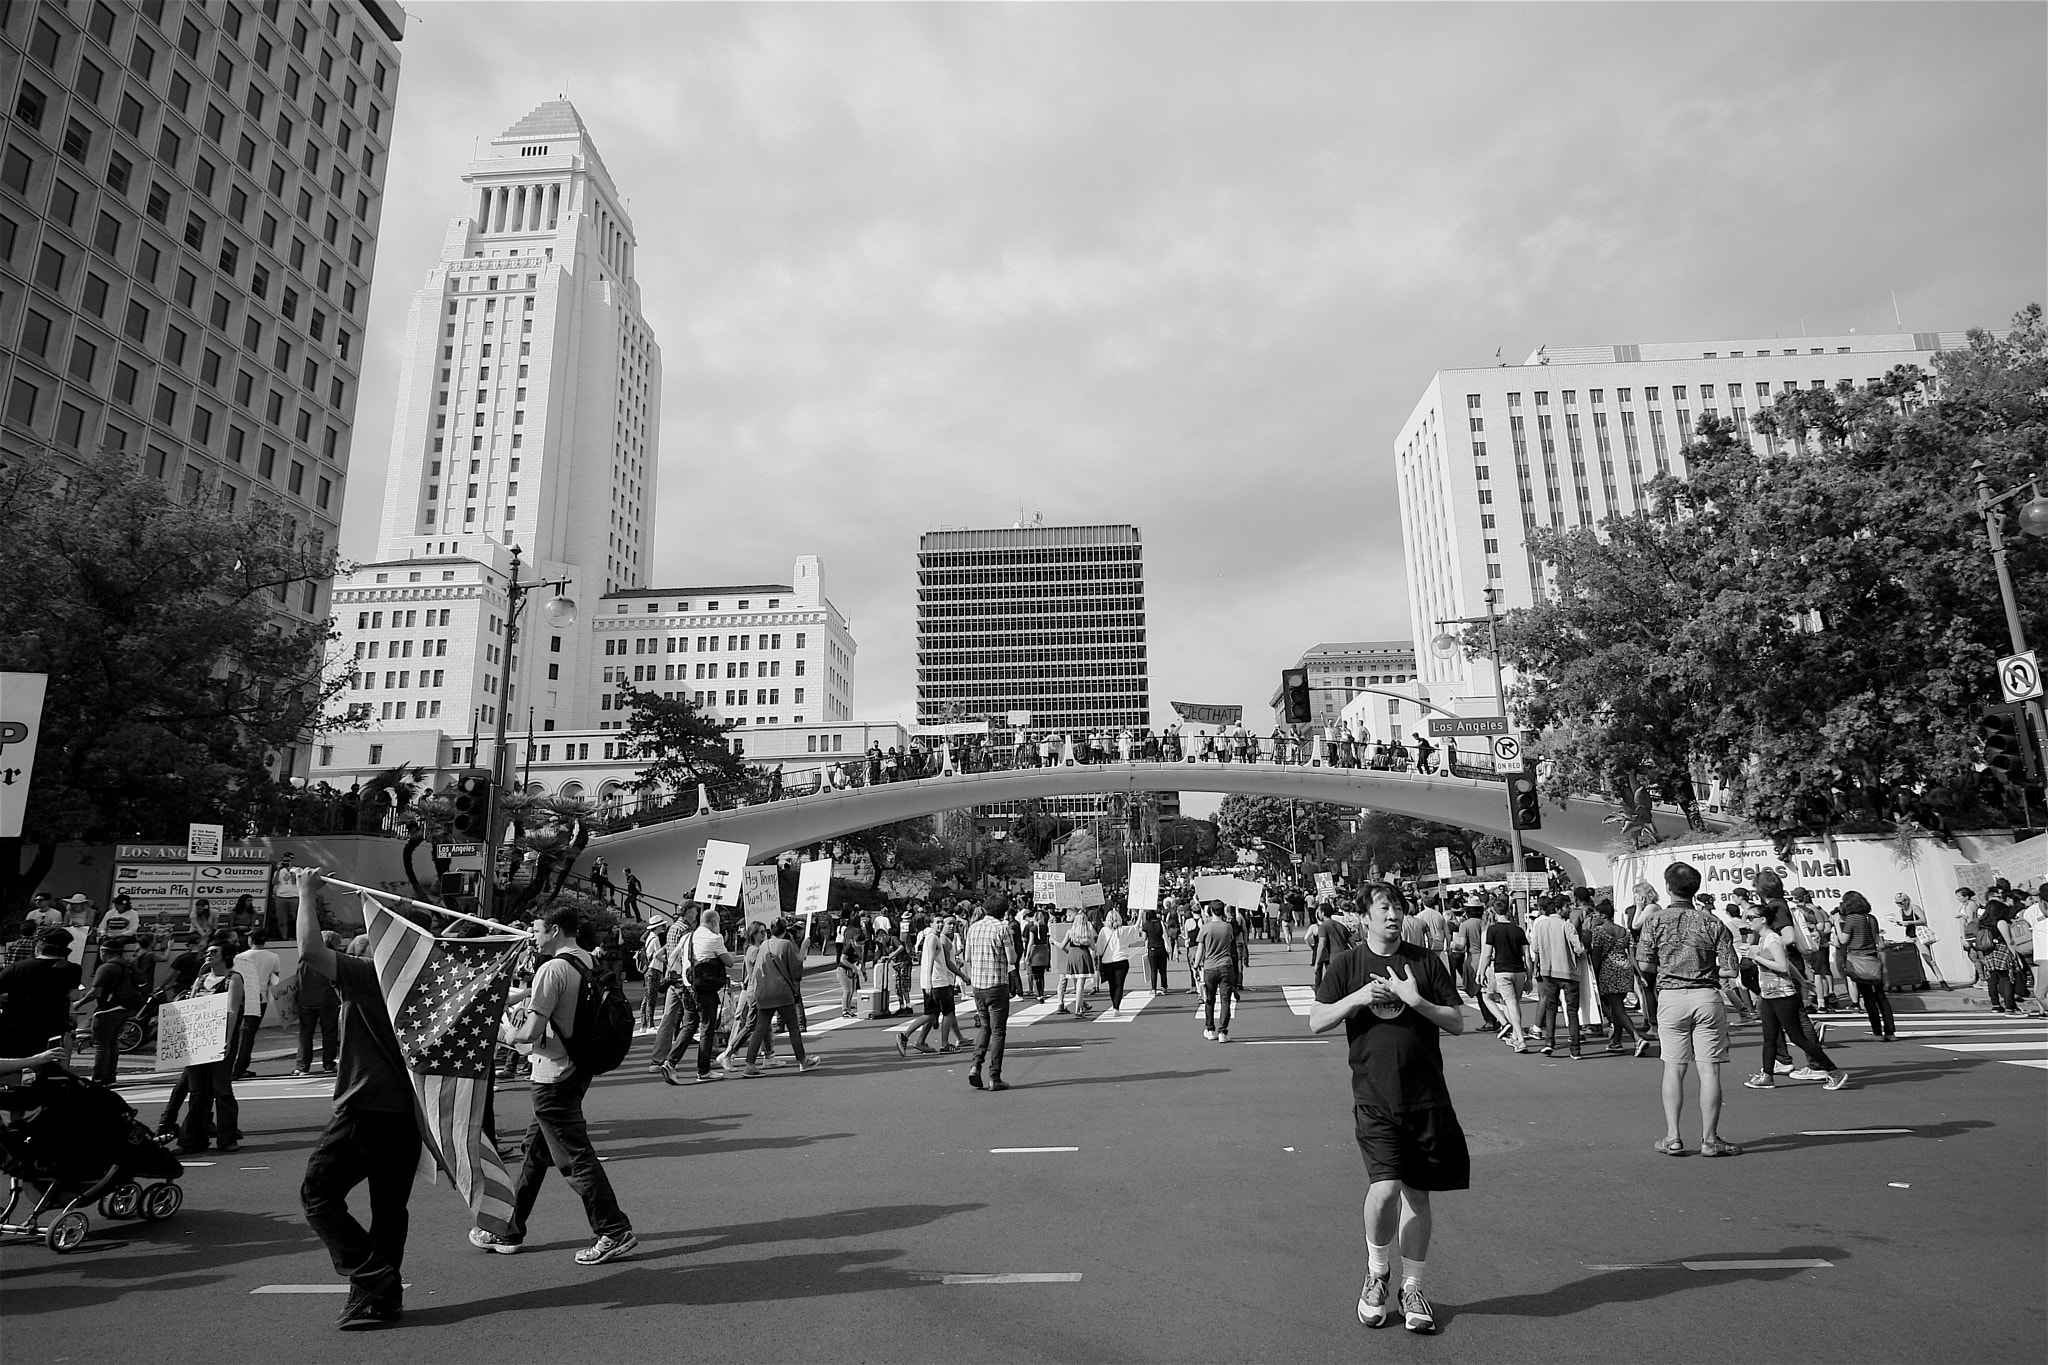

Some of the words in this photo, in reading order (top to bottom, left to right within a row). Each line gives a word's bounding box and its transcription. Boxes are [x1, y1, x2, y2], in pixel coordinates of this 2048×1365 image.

[1432, 722, 1452, 732] Los
[1456, 721, 1503, 734] Angeles
[1498, 762, 1506, 770] ON
[1507, 762, 1520, 770] RED
[121, 846, 151, 858] LOS
[227, 847, 266, 859] MALL
[439, 845, 450, 853] Los
[451, 845, 475, 854] Angeles
[1692, 852, 1725, 861] Fletcher
[1729, 850, 1768, 858] Bowron
[1773, 846, 1814, 855] Suare
[1800, 859, 1851, 877] Mall
[744, 870, 759, 890] Hey
[757, 870, 778, 889] Trump
[117, 886, 167, 895] California
[194, 1008, 226, 1021] DARKNESS
[176, 1023, 193, 1034] LIGHT
[195, 1035, 219, 1047] LOVE
[161, 1051, 174, 1061] CAN
